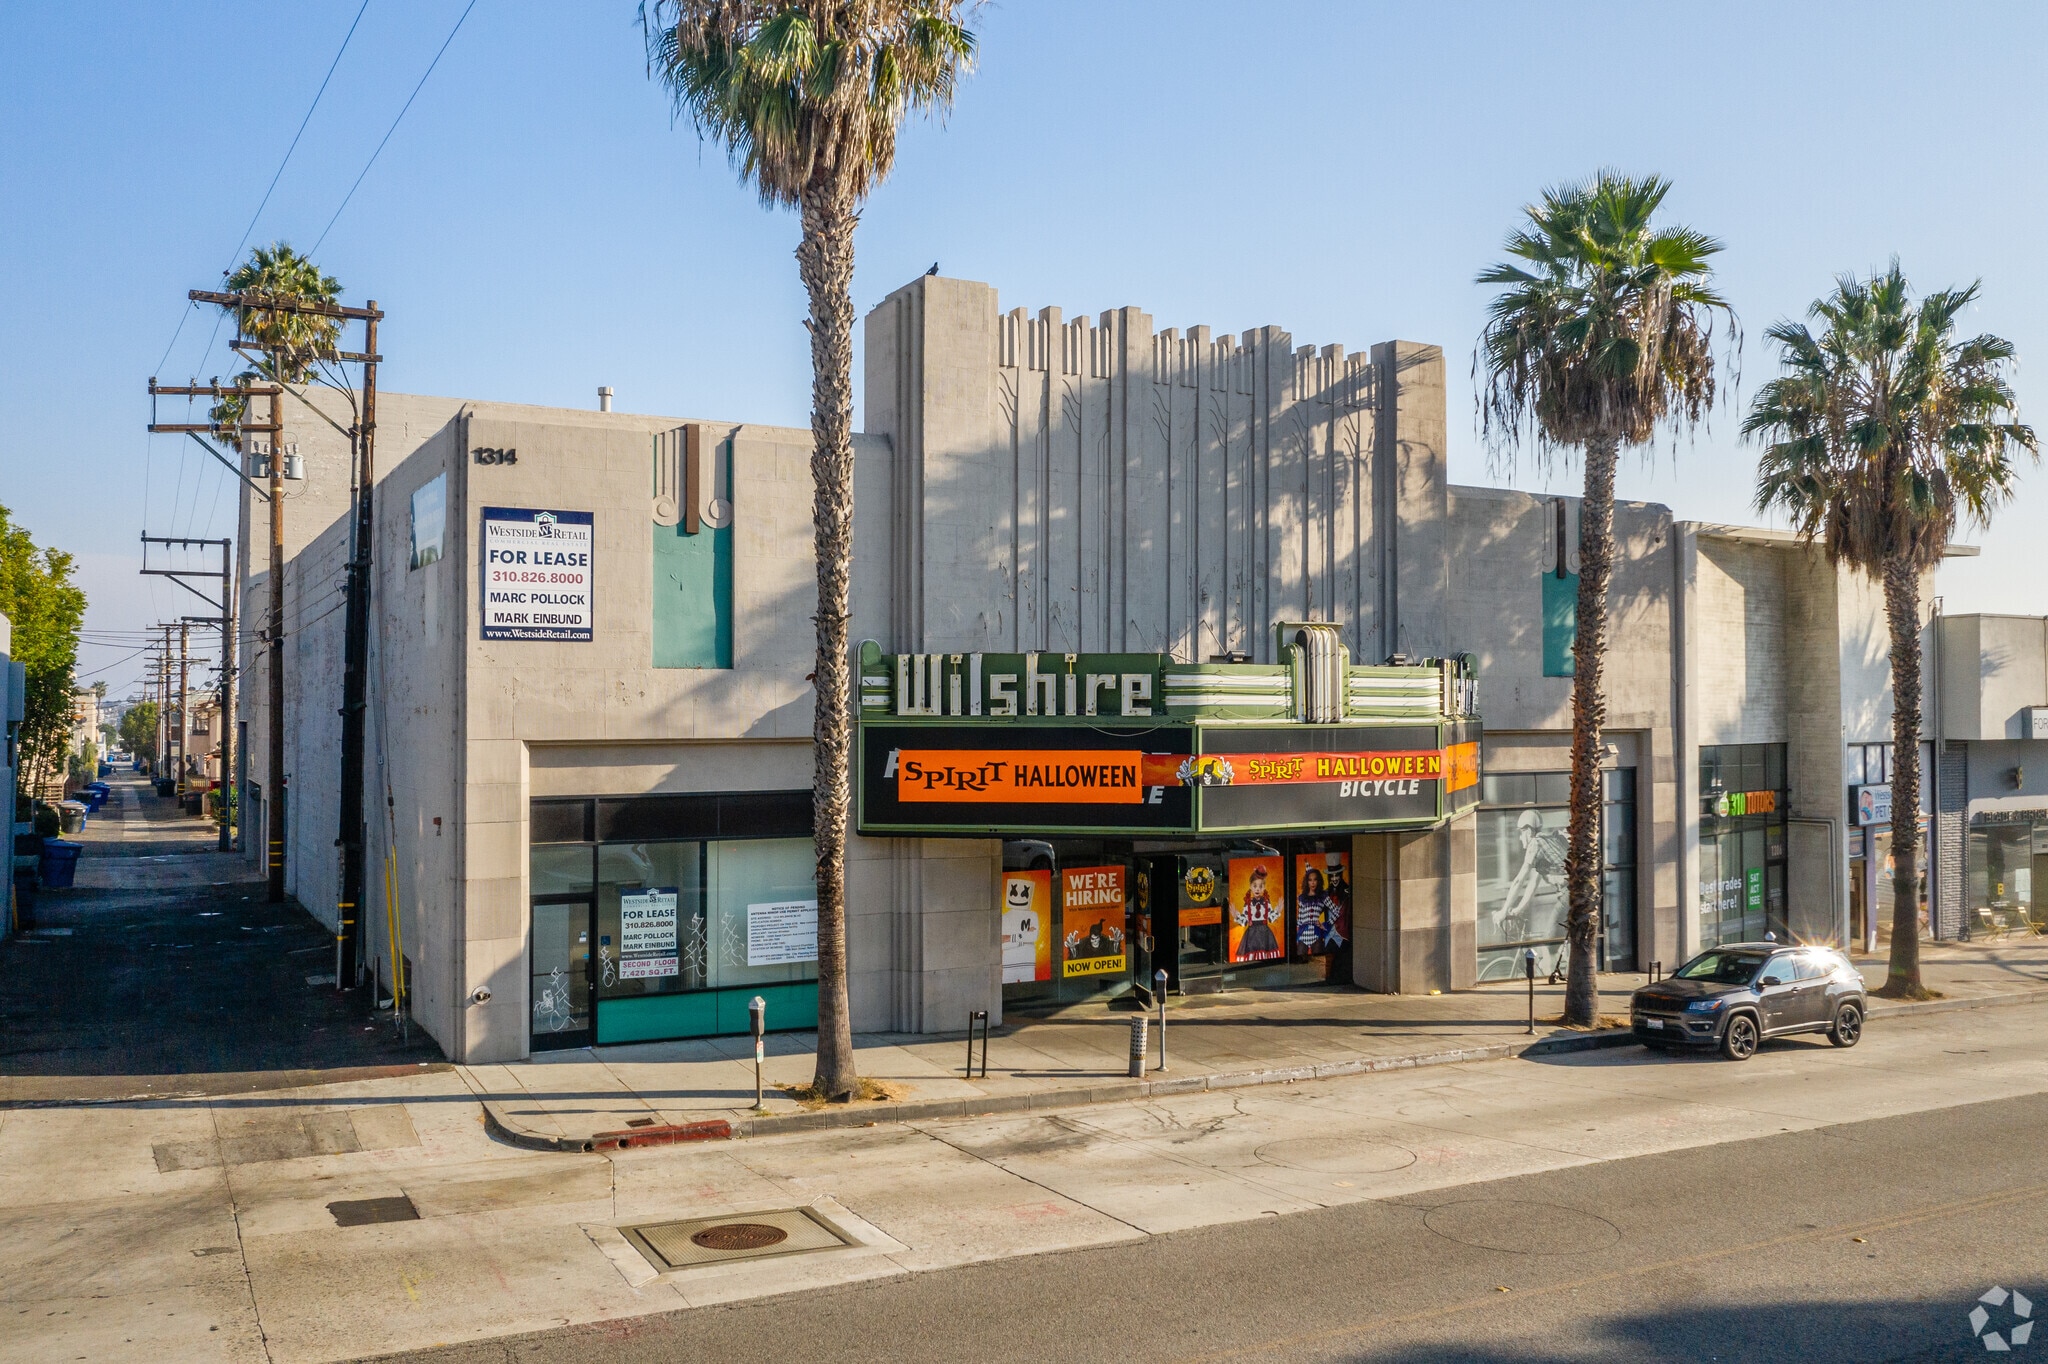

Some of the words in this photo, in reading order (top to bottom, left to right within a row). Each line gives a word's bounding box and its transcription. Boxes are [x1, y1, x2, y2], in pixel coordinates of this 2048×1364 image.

[470, 447, 518, 466] 1314
[489, 525, 537, 538] WESTSIDE
[554, 529, 588, 541] RETAIL
[490, 550, 527, 564] FOR
[534, 551, 588, 567] LEASE
[493, 571, 584, 584] 310.826.8000
[490, 592, 527, 603] MARC
[531, 593, 585, 605] POLLOCK
[494, 612, 529, 623] MARK
[533, 613, 582, 625] EINBUND
[486, 628, 590, 639] www.WestsideRetail.com
[897, 653, 1152, 716] Wilshire
[1249, 758, 1303, 779] SPIRIT
[1317, 756, 1440, 777] HALLOWEEN
[904, 761, 1009, 792] SPIRIT
[1014, 764, 1136, 787] HALLOWEEN
[1340, 779, 1420, 797] BICYCLE
[1731, 792, 1745, 816] 310
[1746, 790, 1775, 815] TUTORS
[1875, 805, 1886, 818] PET
[1069, 872, 1118, 889] WE'RE
[1750, 873, 1760, 882] SAT
[1188, 883, 1212, 893] SPIRIT
[1718, 877, 1742, 895] grades
[1750, 884, 1760, 894] ACT
[1066, 888, 1122, 907] HIRING
[623, 910, 644, 919] FOR
[647, 909, 675, 918] LEASE
[1700, 901, 1717, 915] start
[625, 920, 674, 929] 310.826.8000
[623, 942, 643, 950] MARK
[645, 941, 675, 949] EINBUND
[622, 961, 651, 969] SECOND
[1067, 962, 1091, 973] NOW
[1094, 959, 1122, 970] OPEN!
[648, 968, 677, 976] SQ.FT.
